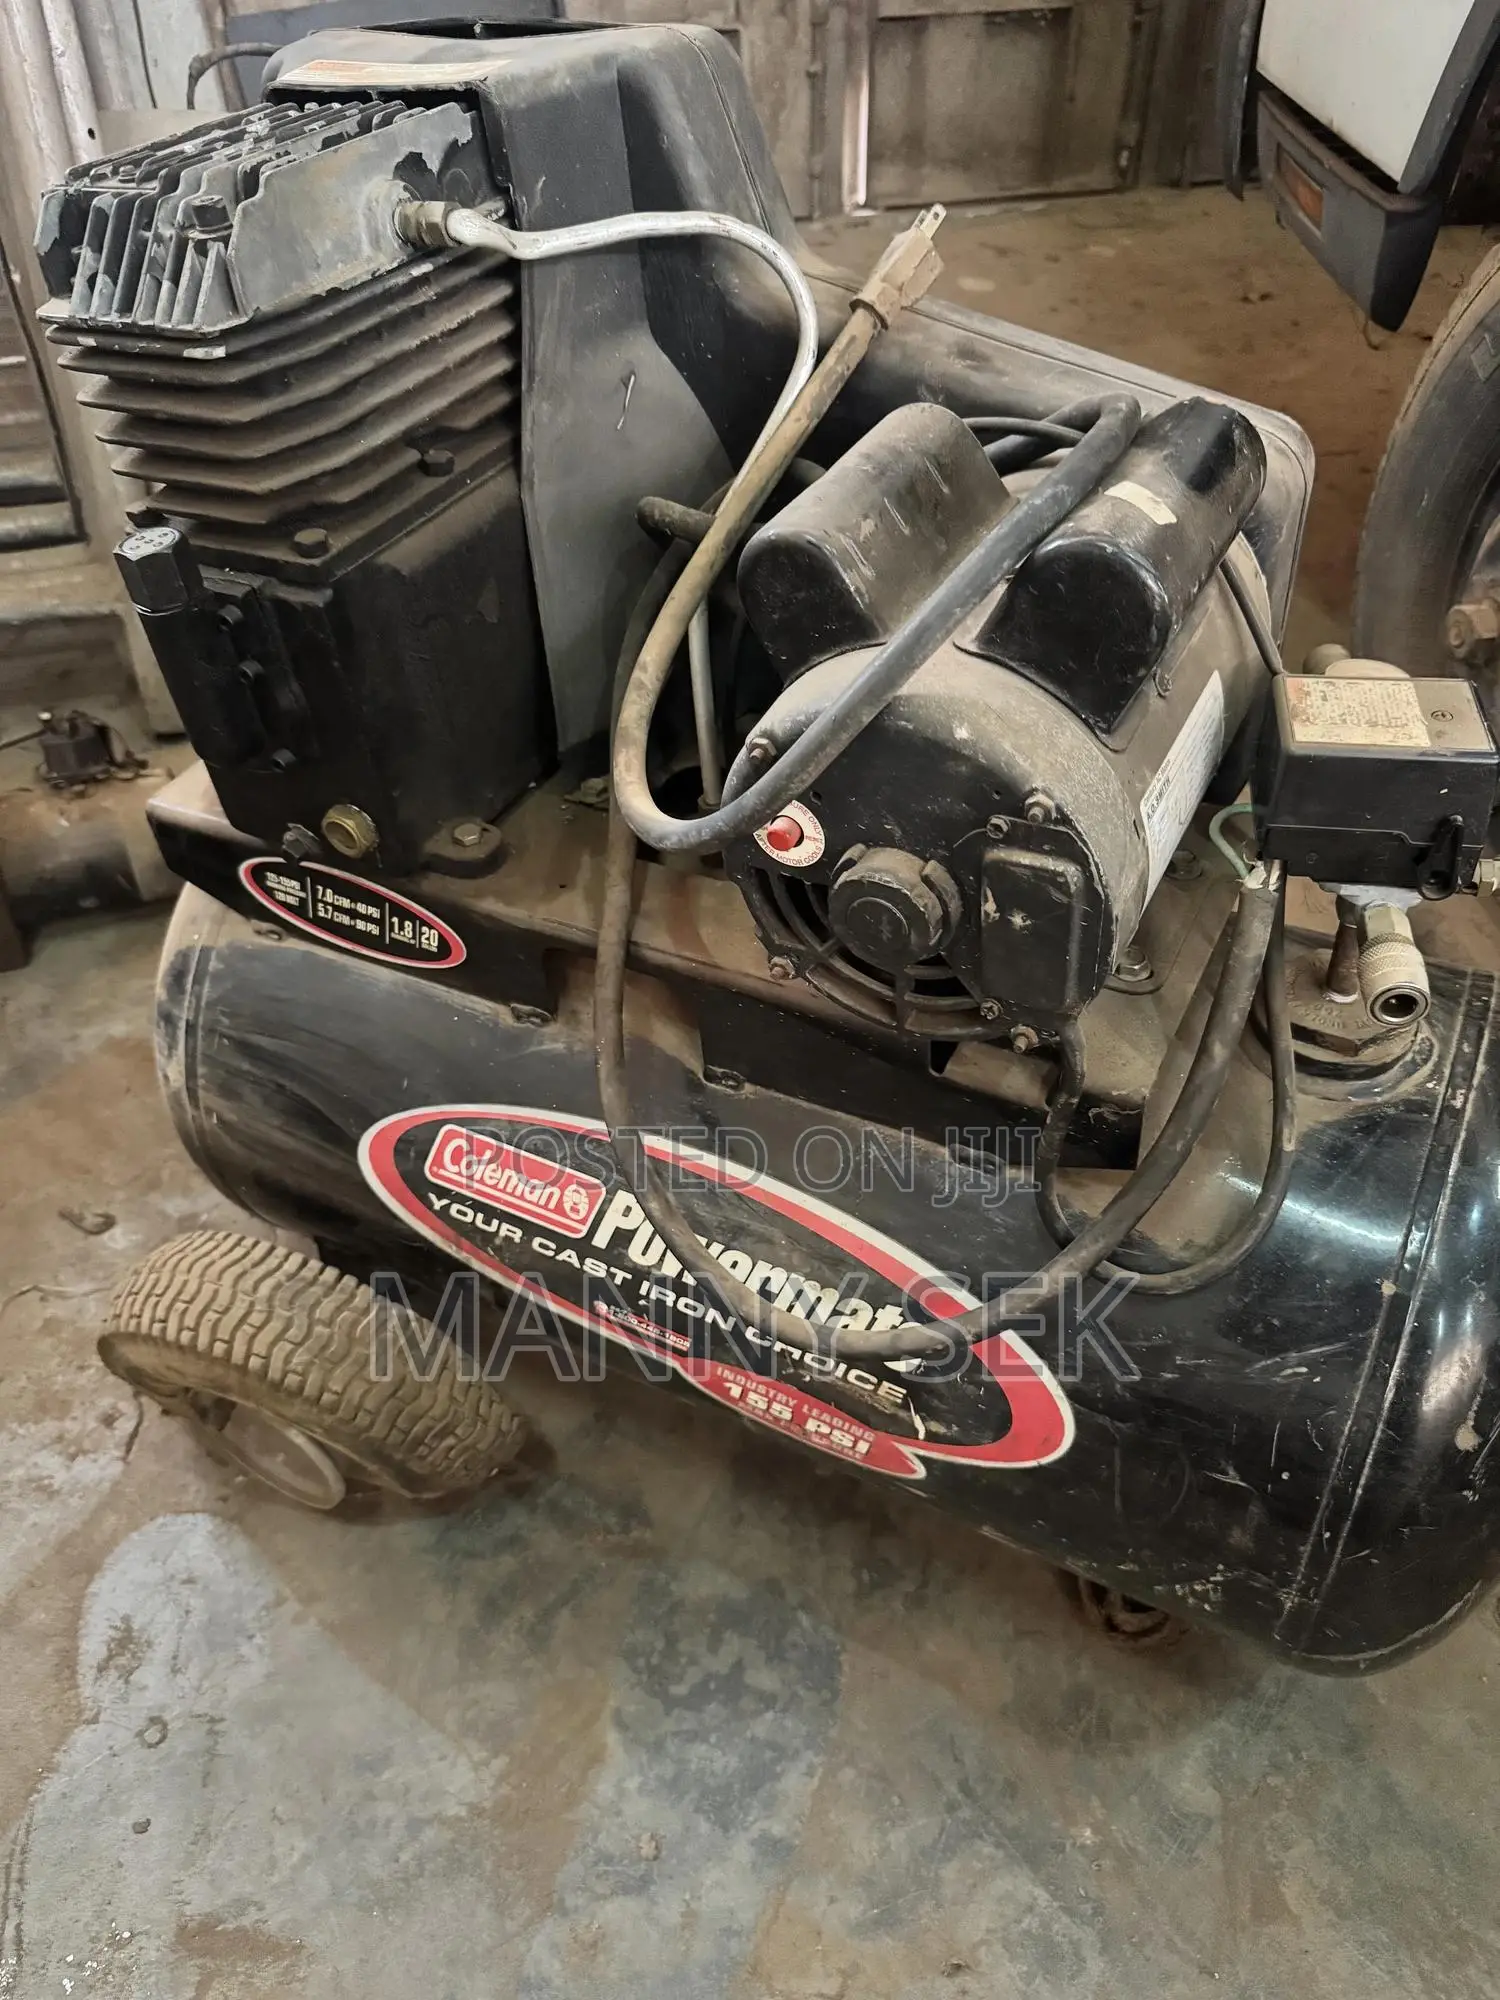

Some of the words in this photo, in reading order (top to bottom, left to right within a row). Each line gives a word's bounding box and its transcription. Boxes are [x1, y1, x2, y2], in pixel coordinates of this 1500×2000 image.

[755, 833, 775, 855] AFTER
[776, 854, 804, 866] MOTOR
[804, 845, 823, 864] COOLS
[316, 885, 333, 901] 7.0
[333, 895, 350, 909] CFM
[356, 902, 367, 914] 40
[367, 905, 380, 919] PSI
[317, 902, 333, 919] 5.7
[333, 911, 350, 926] CFM
[355, 919, 366, 930] 90
[367, 923, 380, 935] PSI
[391, 917, 413, 938] 1.8
[421, 926, 438, 947] 20
[443, 1138, 561, 1210] Coleman
[427, 1192, 523, 1244] YOUR
[532, 1236, 632, 1286] CAST
[639, 1280, 736, 1332] IRON
[716, 1367, 798, 1408] INDUSTRY
[802, 1404, 876, 1442] LEADING
[723, 1382, 793, 1421] 155
[804, 1417, 871, 1455] PSI
